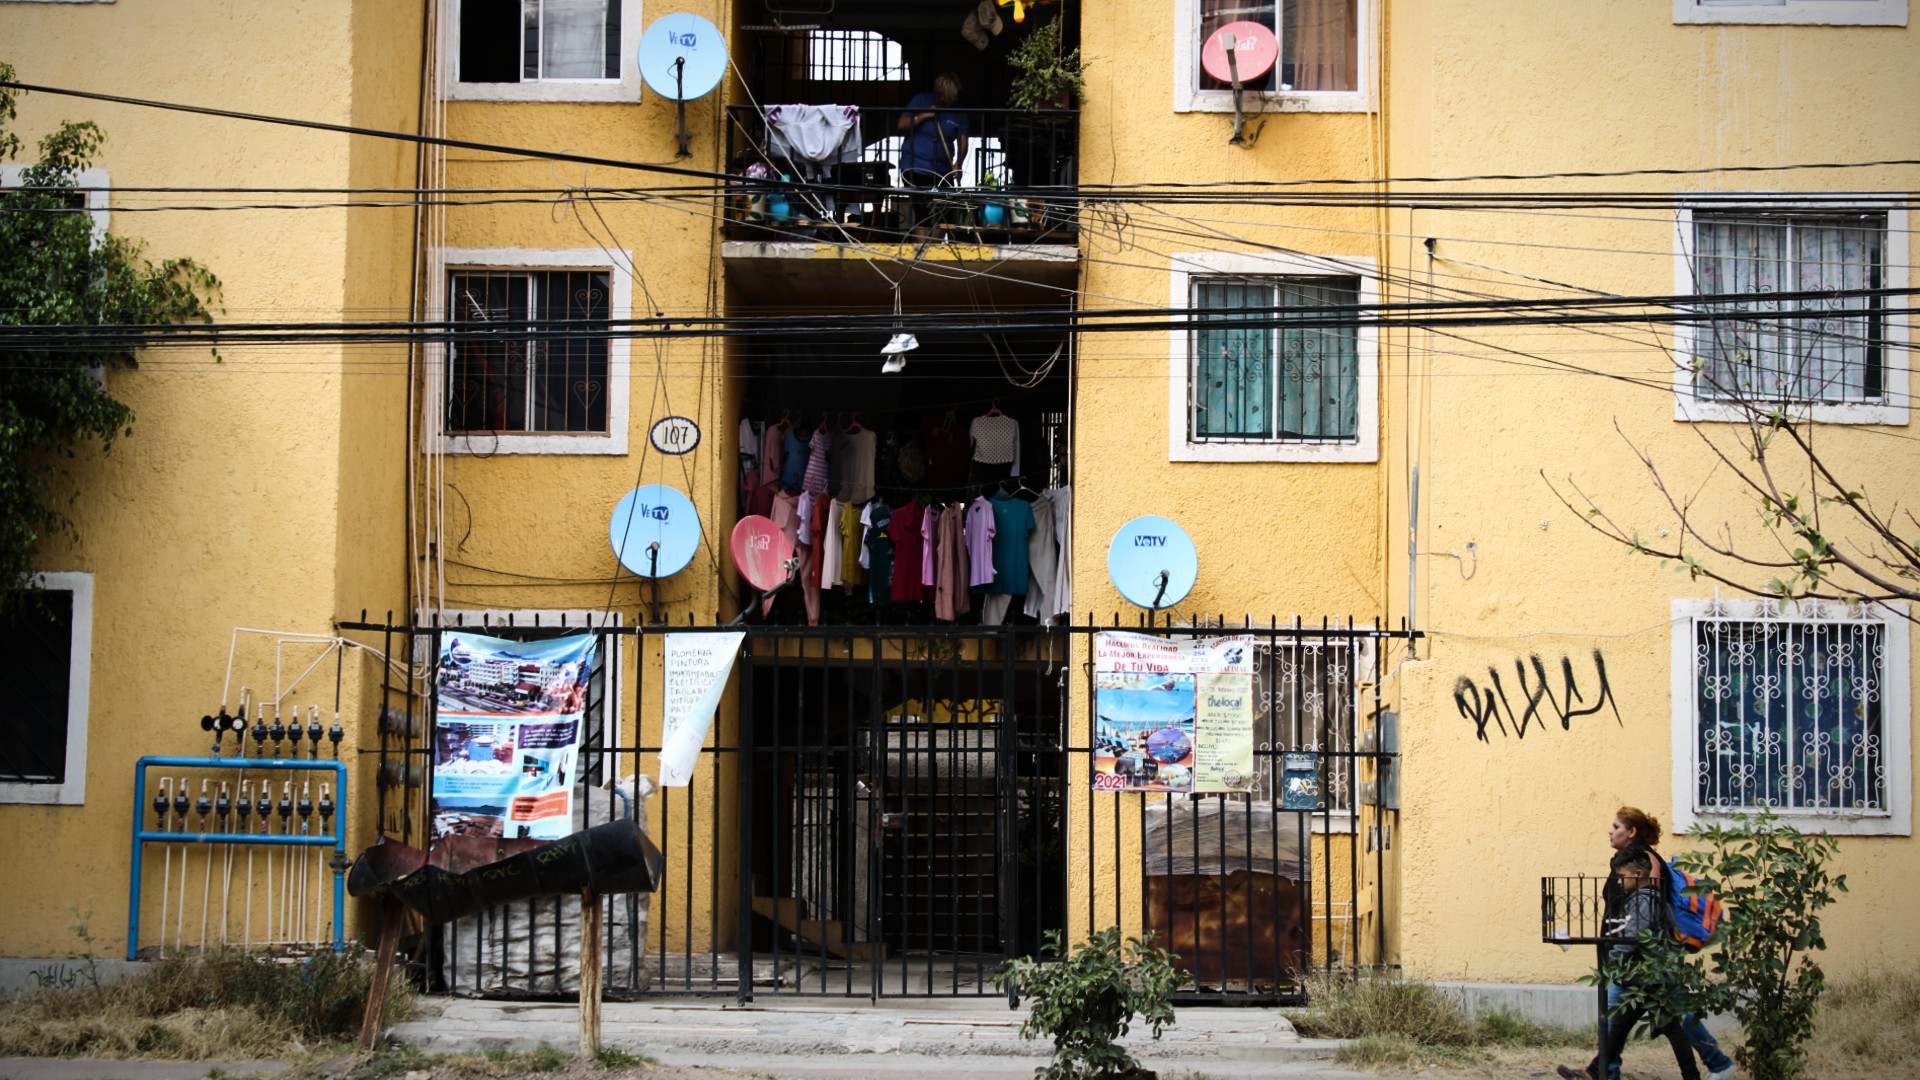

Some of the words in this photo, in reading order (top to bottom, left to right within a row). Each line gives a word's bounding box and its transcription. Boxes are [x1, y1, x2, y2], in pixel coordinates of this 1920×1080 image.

[663, 426, 689, 444] 107
[671, 658, 710, 668] PINTURA
[1146, 662, 1169, 672] VIDA
[1095, 774, 1127, 790] 2021
